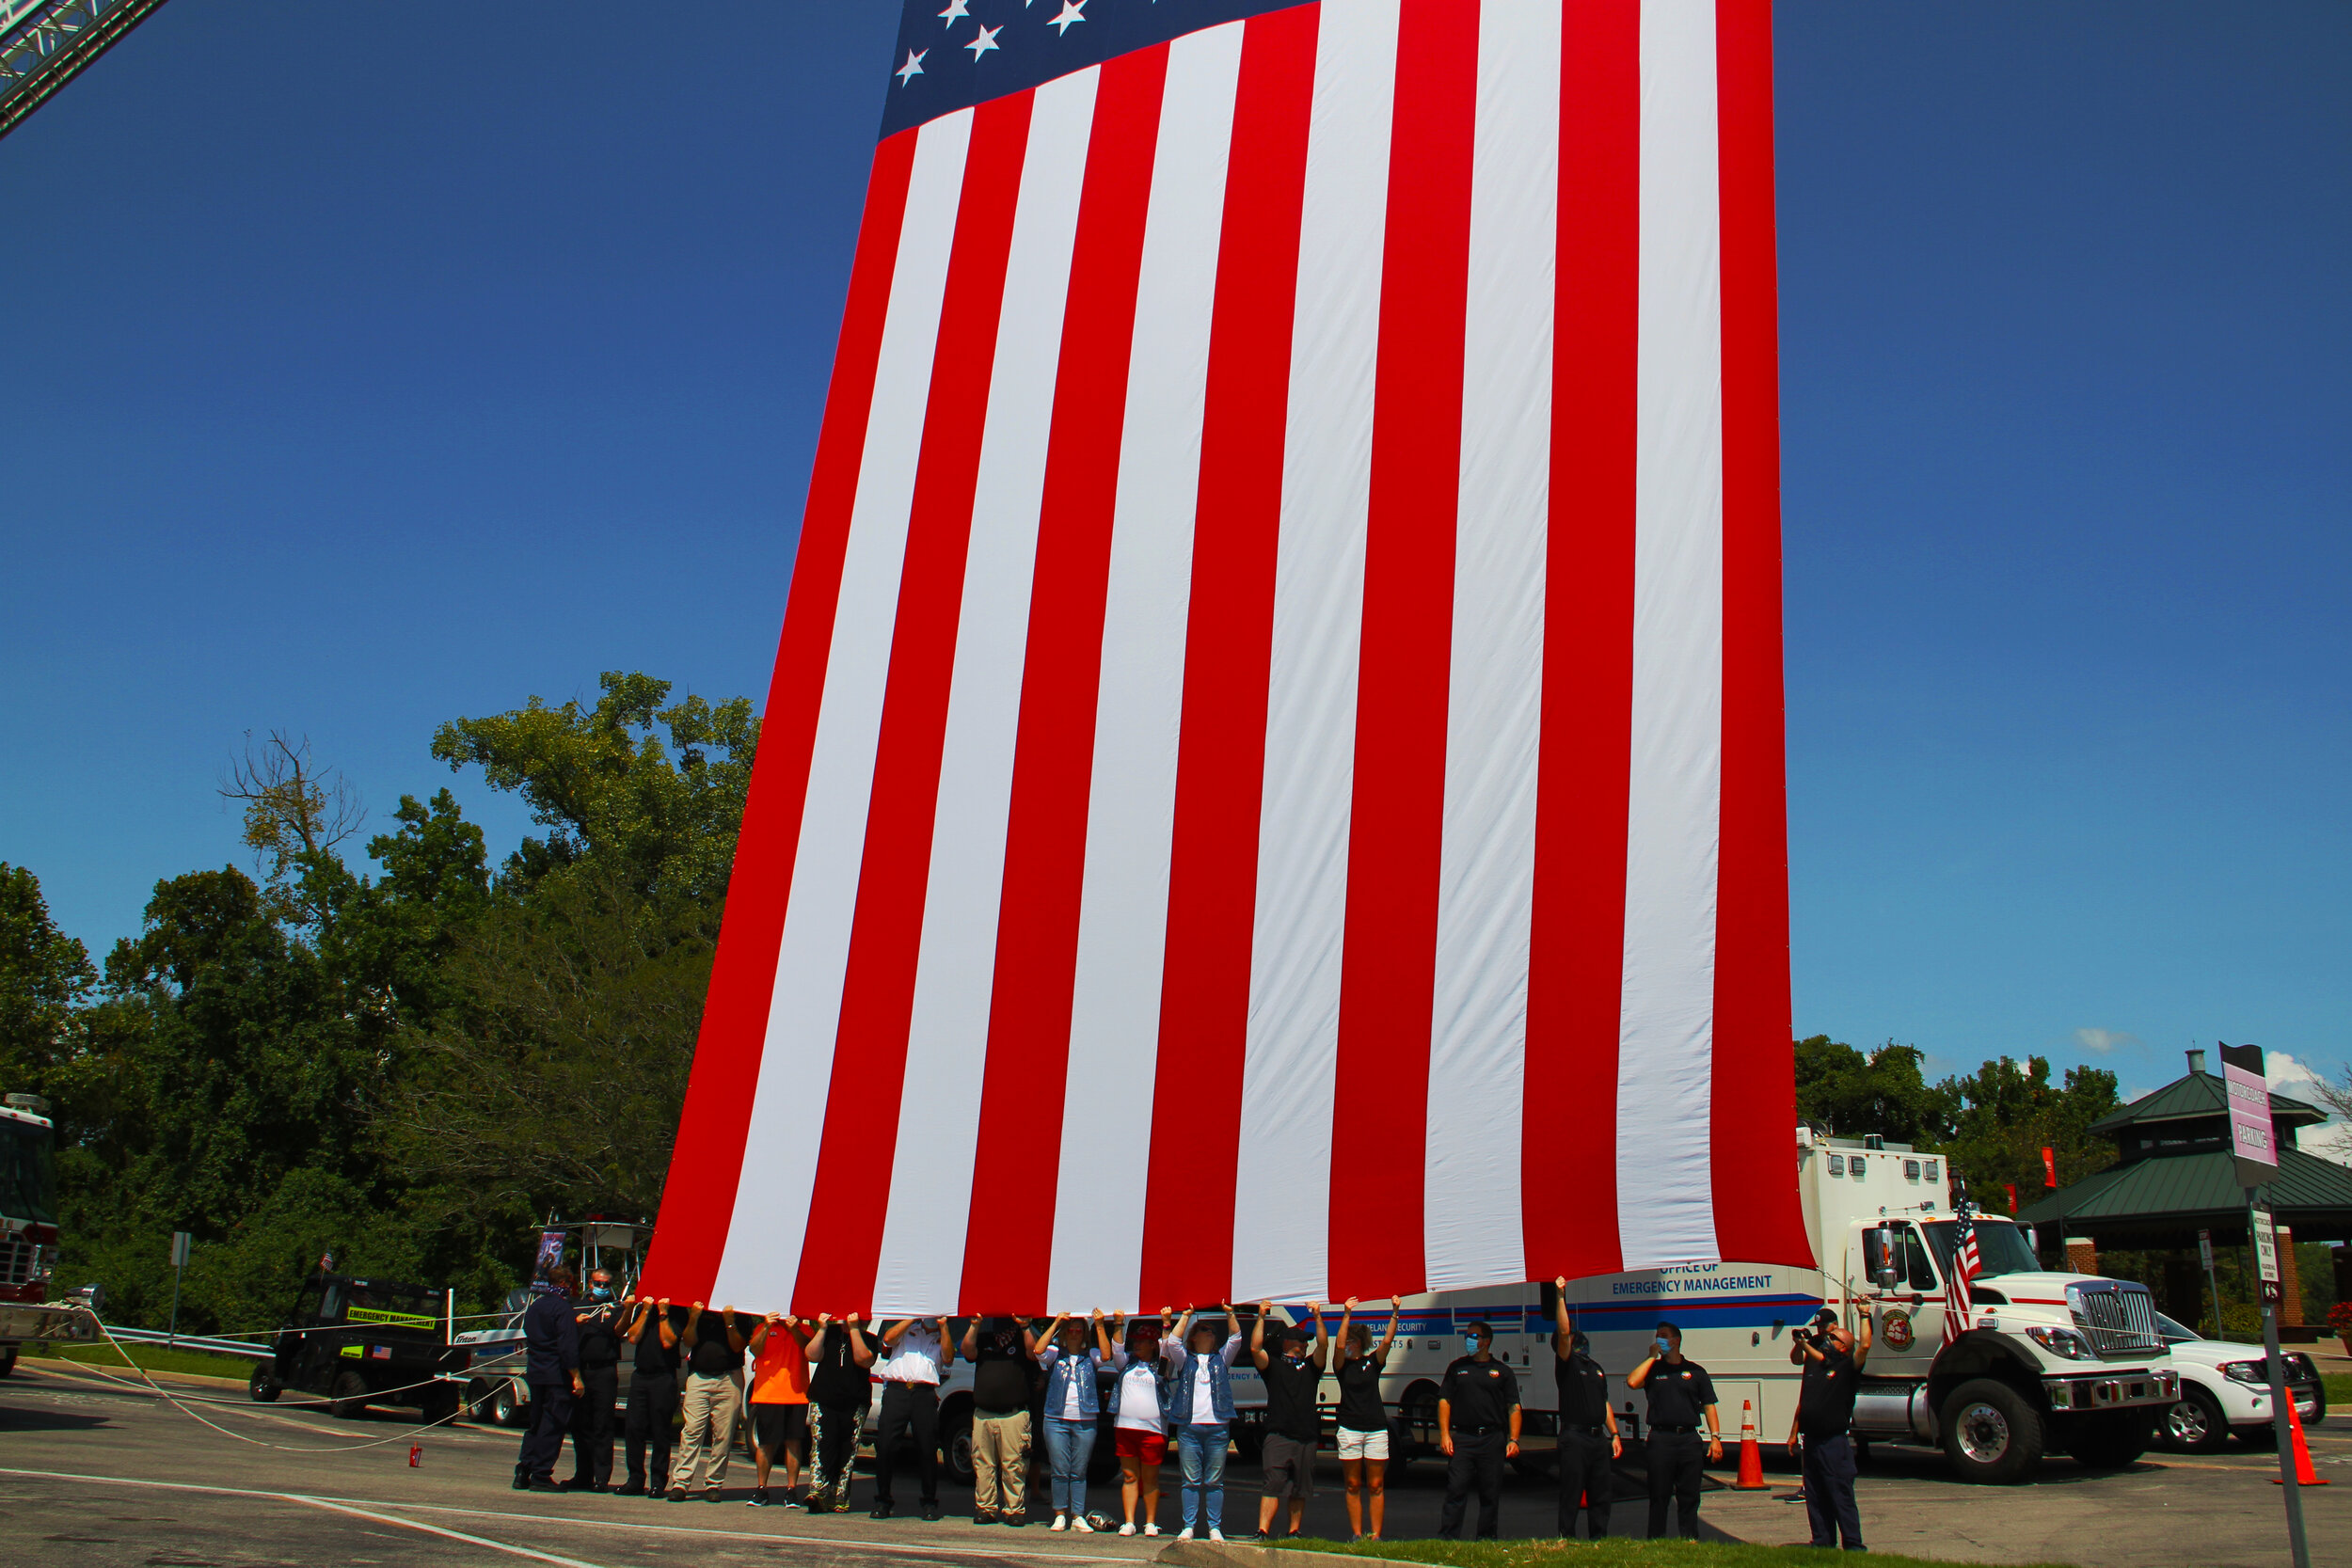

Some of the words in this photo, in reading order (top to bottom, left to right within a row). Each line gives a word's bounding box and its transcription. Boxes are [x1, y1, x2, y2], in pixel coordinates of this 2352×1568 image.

[2237, 1122, 2267, 1150] PARKING
[1613, 1280, 1681, 1294] EMERGENCY
[1683, 1275, 1772, 1291] MANAGEMENT
[349, 1309, 389, 1322] EMERGENCY
[1397, 1322, 1427, 1332] ECURITY
